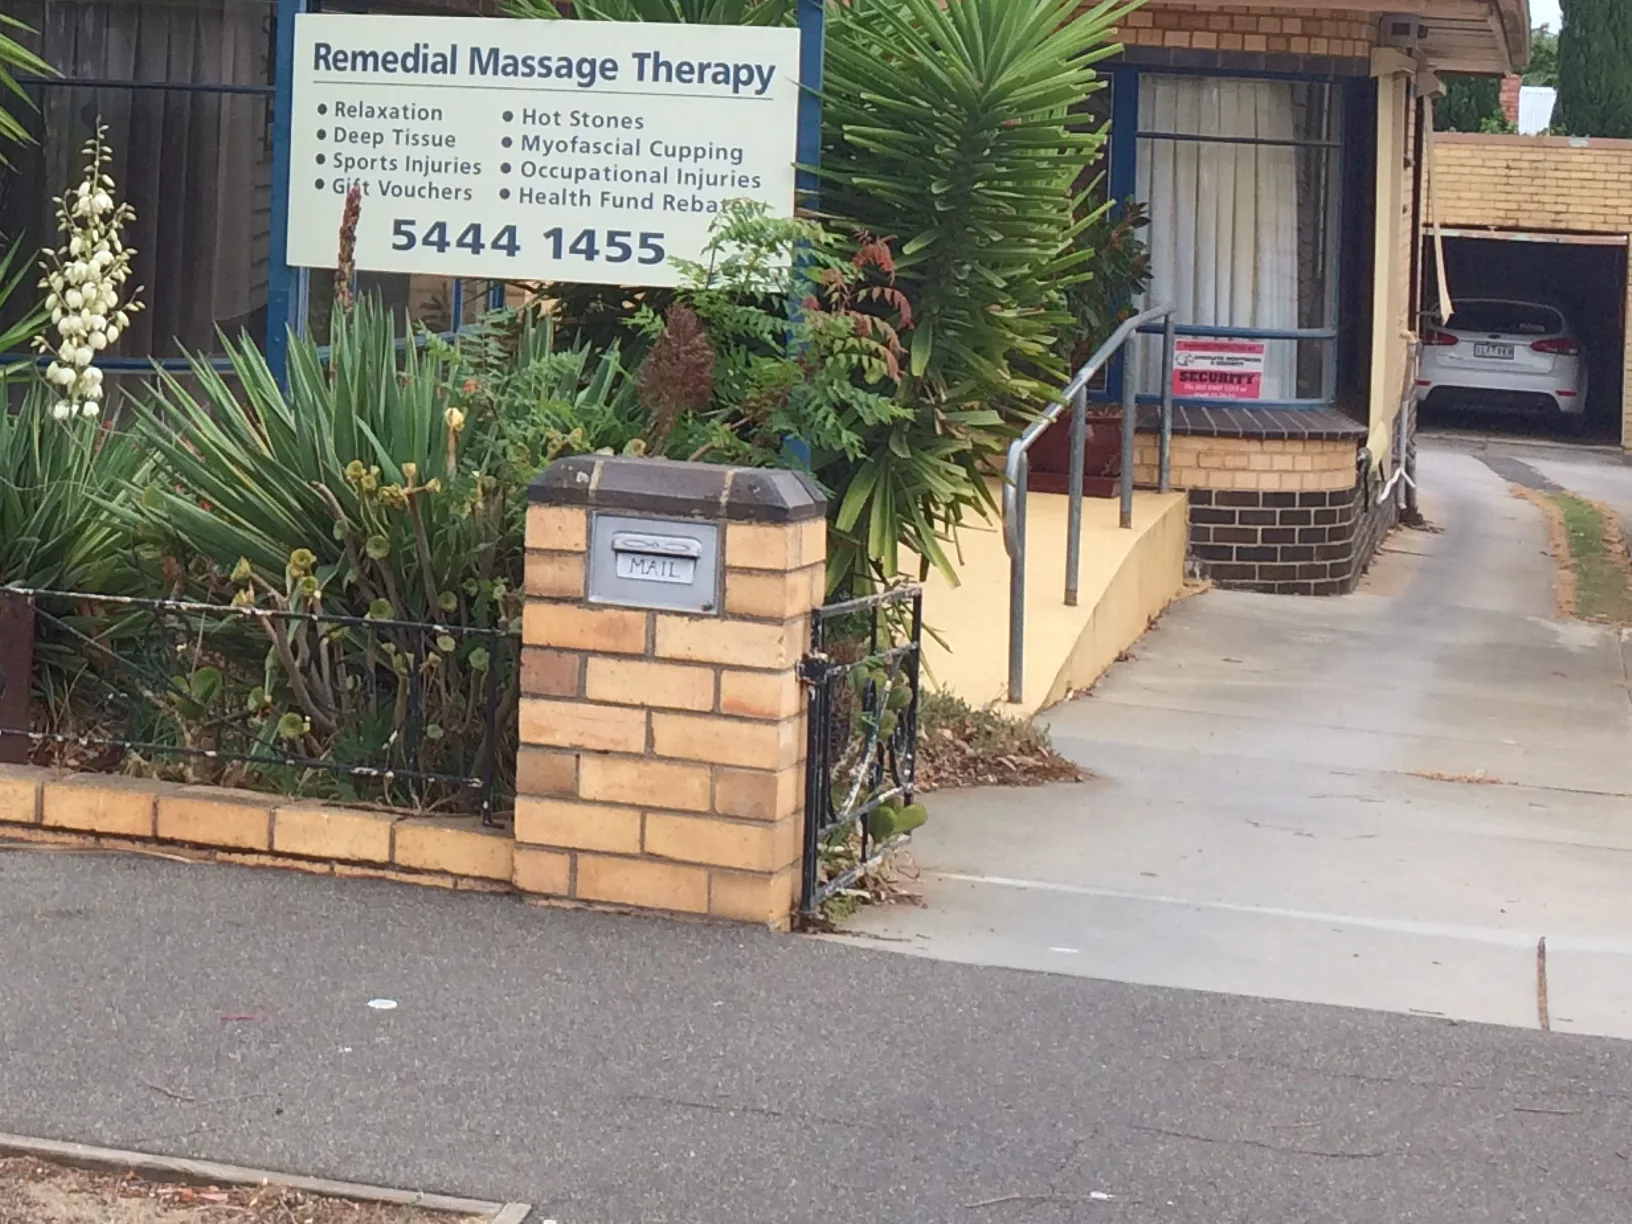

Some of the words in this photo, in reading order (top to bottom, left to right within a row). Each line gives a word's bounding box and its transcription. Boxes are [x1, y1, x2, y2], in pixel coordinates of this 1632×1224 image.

[313, 42, 458, 76] Remedial
[468, 46, 619, 89] Massage
[632, 51, 776, 96] Therapy
[334, 100, 443, 122] Relaxation
[521, 108, 561, 127] Hot
[569, 110, 644, 130] Stones
[334, 126, 385, 149] Deep
[391, 128, 456, 149] Tissue
[520, 134, 641, 157] Myofascial
[649, 140, 744, 165] Cupping
[333, 151, 398, 174] Sports
[405, 155, 483, 178] Injuries
[520, 160, 668, 184] Occupational
[676, 167, 761, 191] Injuries
[378, 179, 473, 201] Vouchers
[518, 187, 591, 208] Health
[600, 191, 654, 210] Fund
[391, 218, 521, 258] 5444
[542, 227, 666, 266] 1455
[1178, 370, 1255, 385] SECURITY
[628, 557, 681, 578] MAIL
